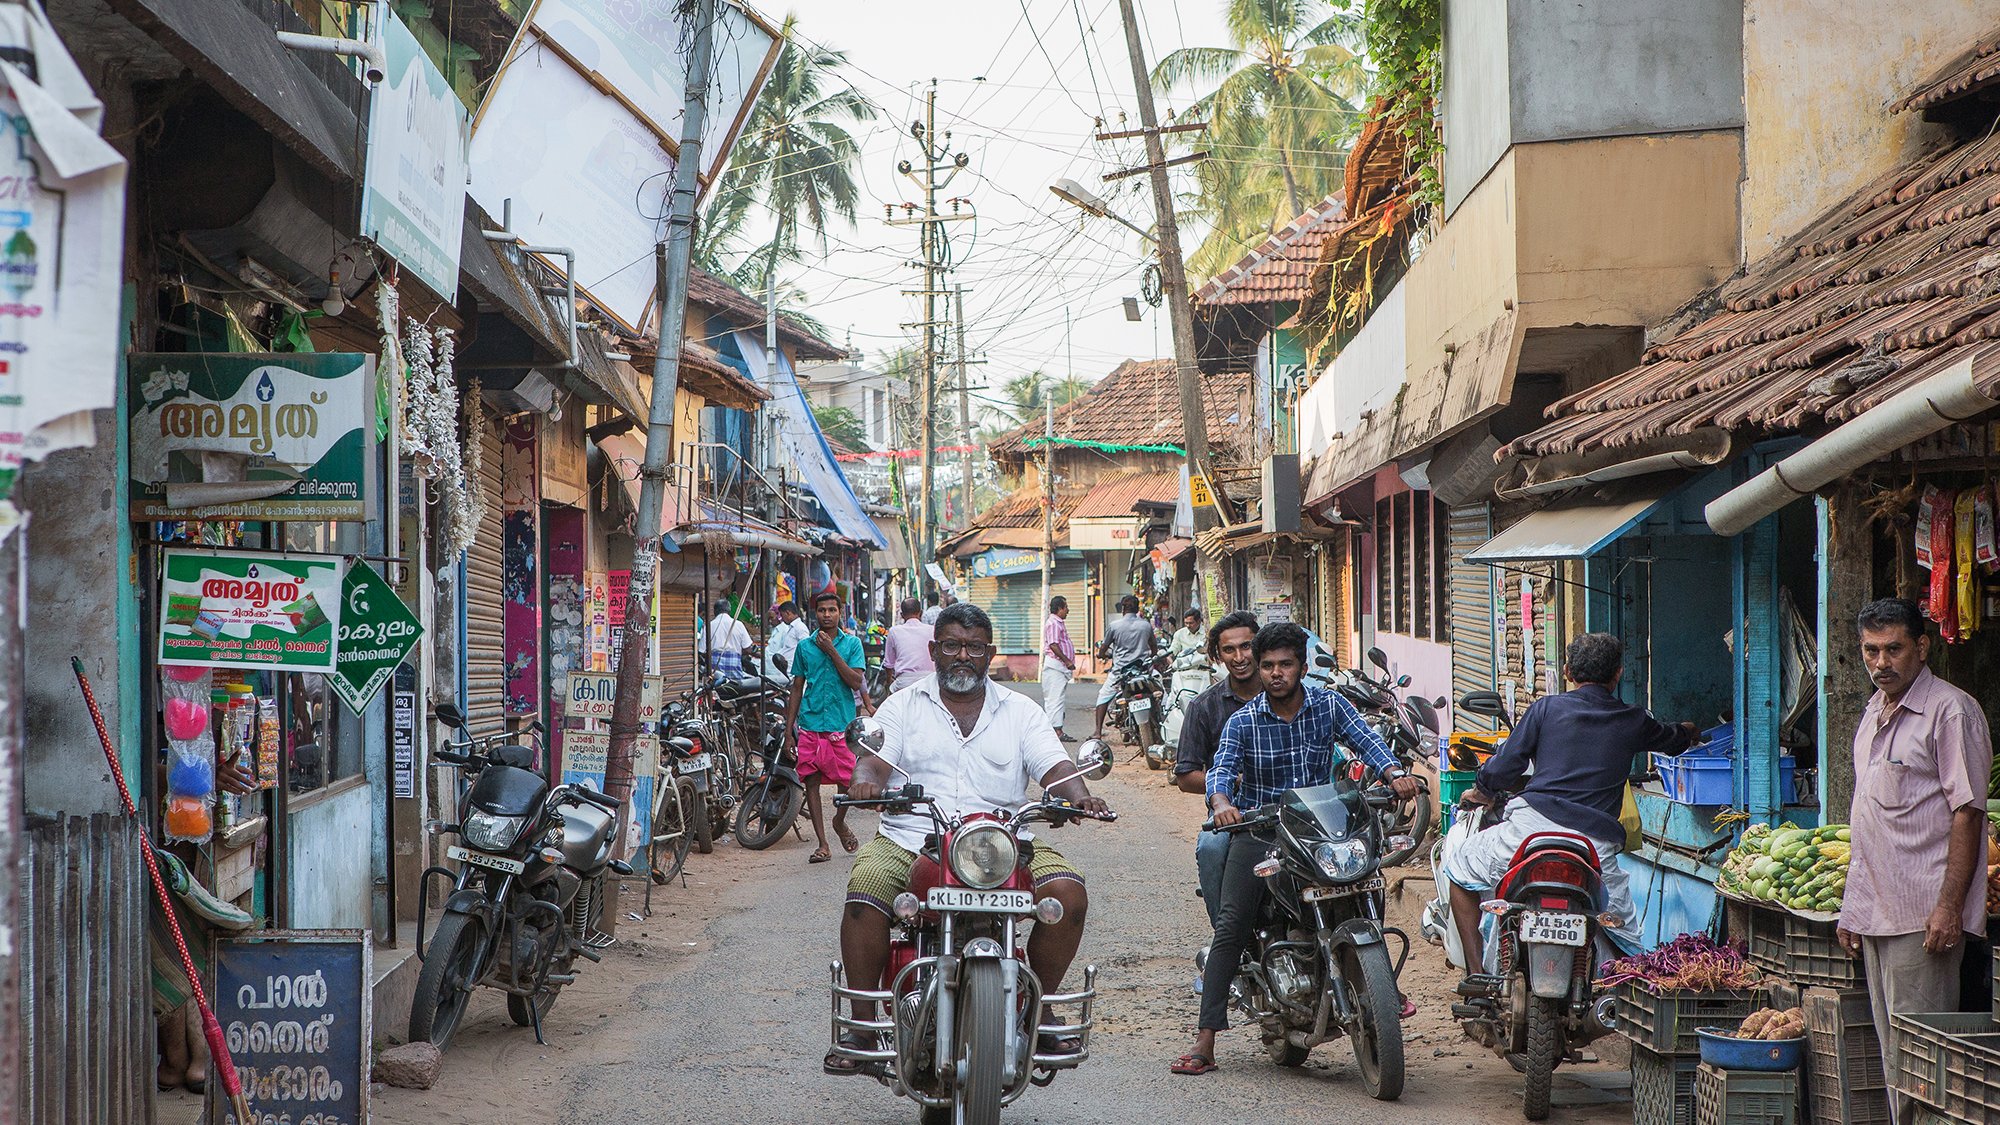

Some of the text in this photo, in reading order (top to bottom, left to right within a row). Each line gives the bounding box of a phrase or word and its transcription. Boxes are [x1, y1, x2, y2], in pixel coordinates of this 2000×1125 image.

[1276, 363, 1323, 391] Ka
[160, 390, 328, 453] അമൃത്
[299, 479, 358, 499] ലഭിക്കുന്നു
[1003, 554, 1037, 568] SALOON
[202, 576, 305, 608] അമൃത്
[285, 639, 329, 653] തൈര്
[458, 851, 467, 860] KL
[473, 854, 483, 864] 55
[484, 857, 489, 865] J
[1535, 916, 1572, 929] KL 54
[1529, 927, 1578, 941] F 4160
[237, 969, 328, 1010] പാൽ
[226, 1013, 335, 1054] തൈര്
